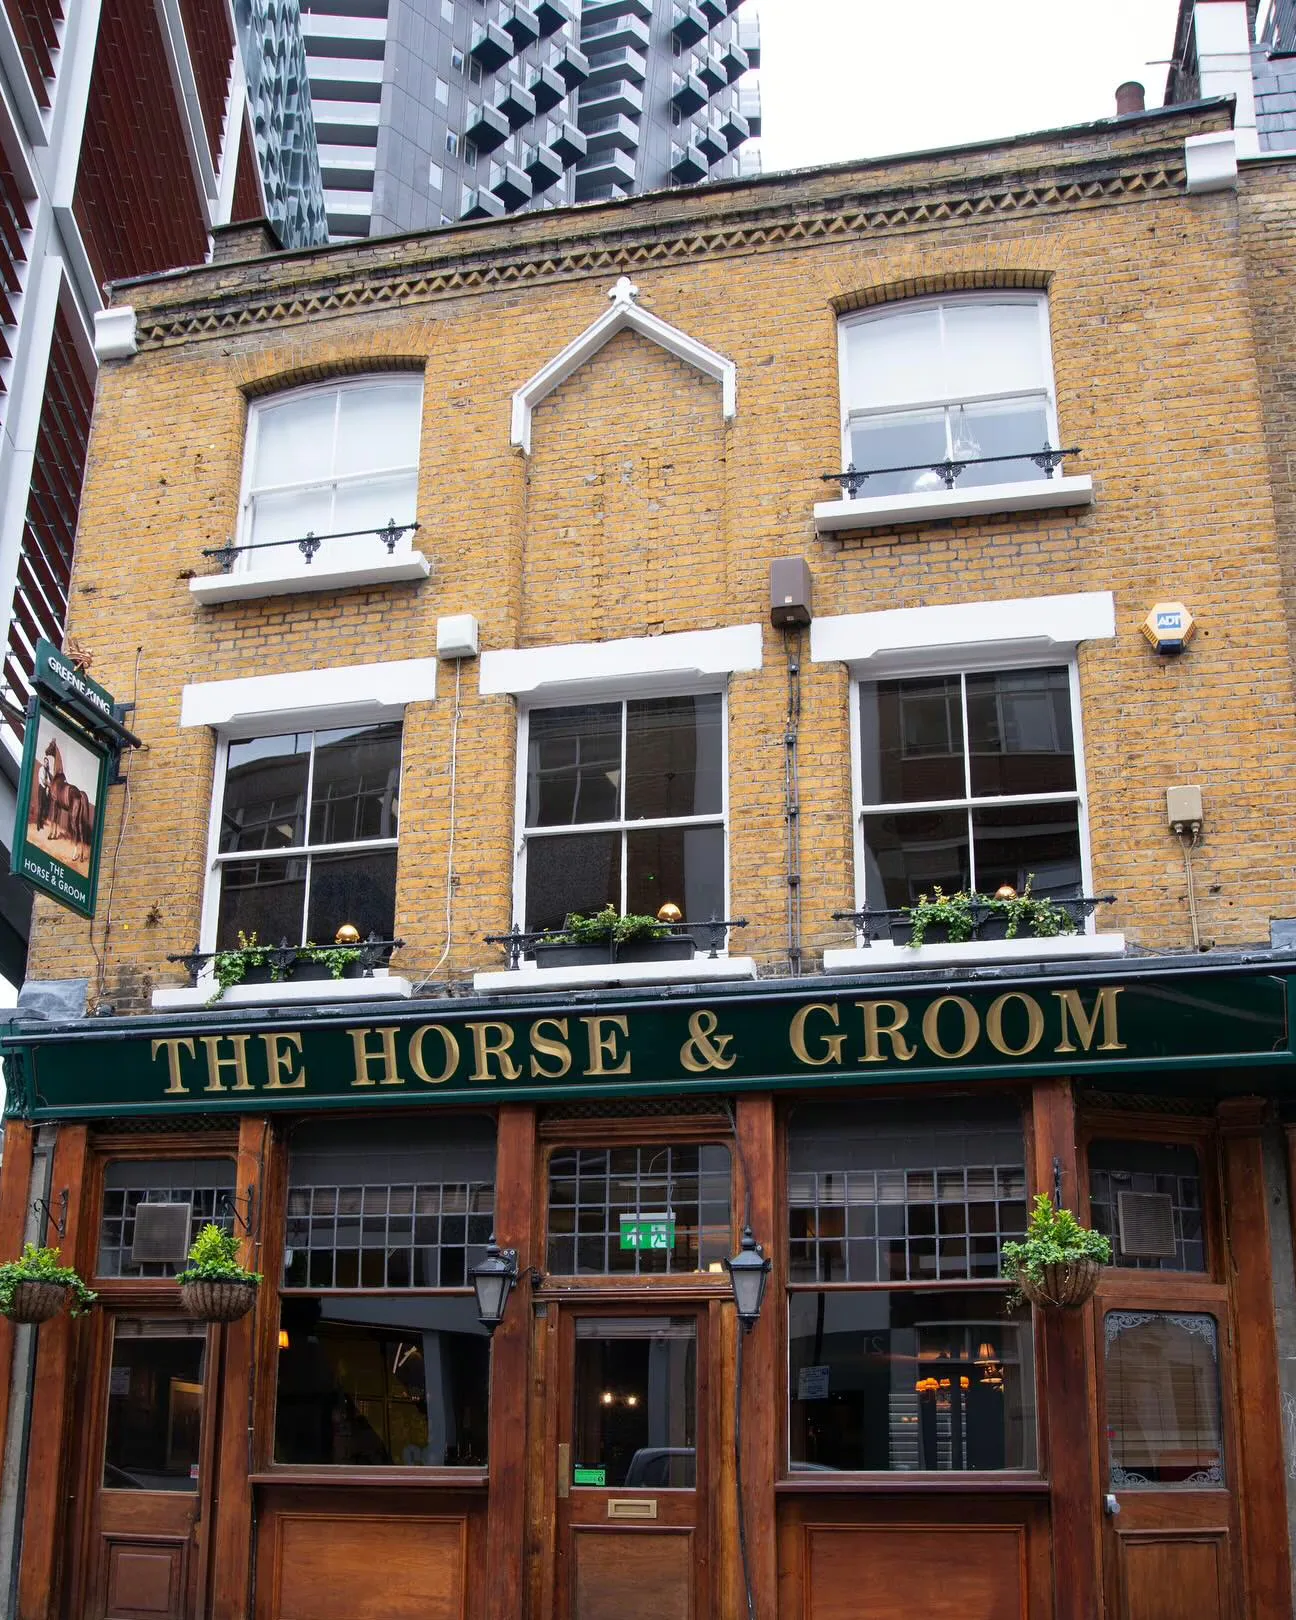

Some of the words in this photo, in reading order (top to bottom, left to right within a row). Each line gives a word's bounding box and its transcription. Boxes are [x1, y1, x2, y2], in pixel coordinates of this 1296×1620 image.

[1158, 615, 1180, 626] ADT
[48, 656, 86, 695] GREENE
[24, 858, 50, 882] HORSE
[50, 875, 58, 887] &
[58, 880, 86, 904] GROOM
[49, 861, 64, 879] THE
[151, 1032, 306, 1094] THE
[346, 1015, 632, 1086] HORSE
[679, 1009, 736, 1072] &
[788, 986, 1128, 1066] GROOM
